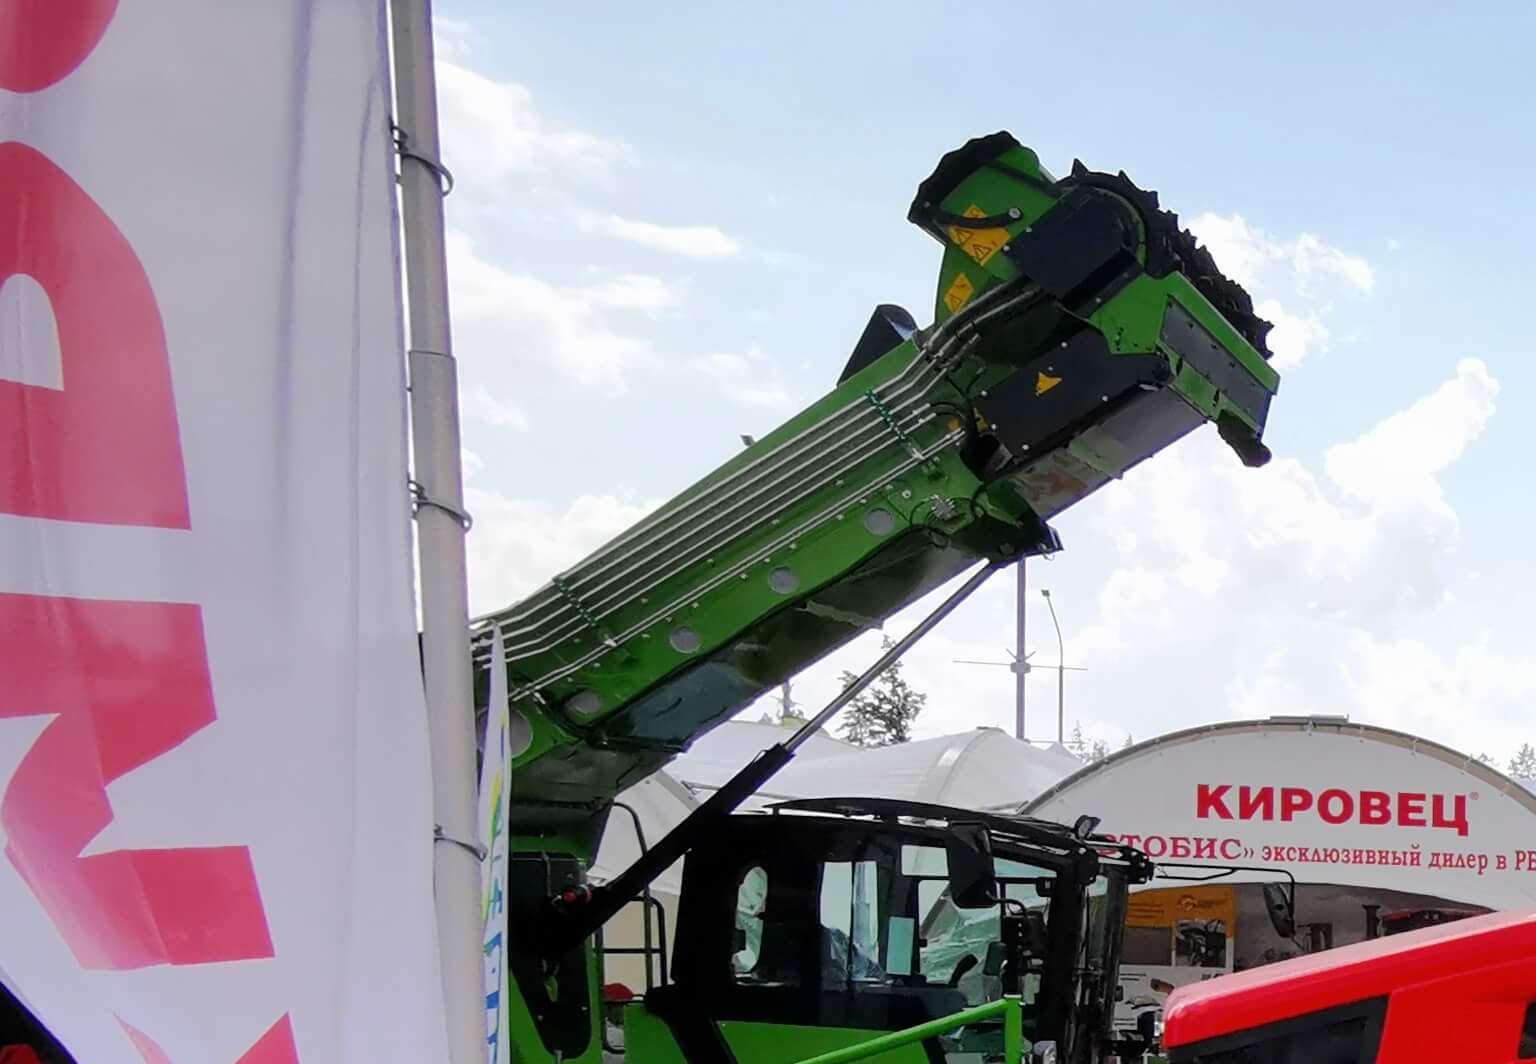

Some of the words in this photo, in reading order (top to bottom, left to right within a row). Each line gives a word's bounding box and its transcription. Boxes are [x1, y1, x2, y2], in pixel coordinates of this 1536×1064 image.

[1195, 783, 1469, 837] КИРОВЕЦ
[1261, 843, 1422, 868] эксклюзивный
[1427, 851, 1489, 876] дилер
[1495, 854, 1508, 870] в
